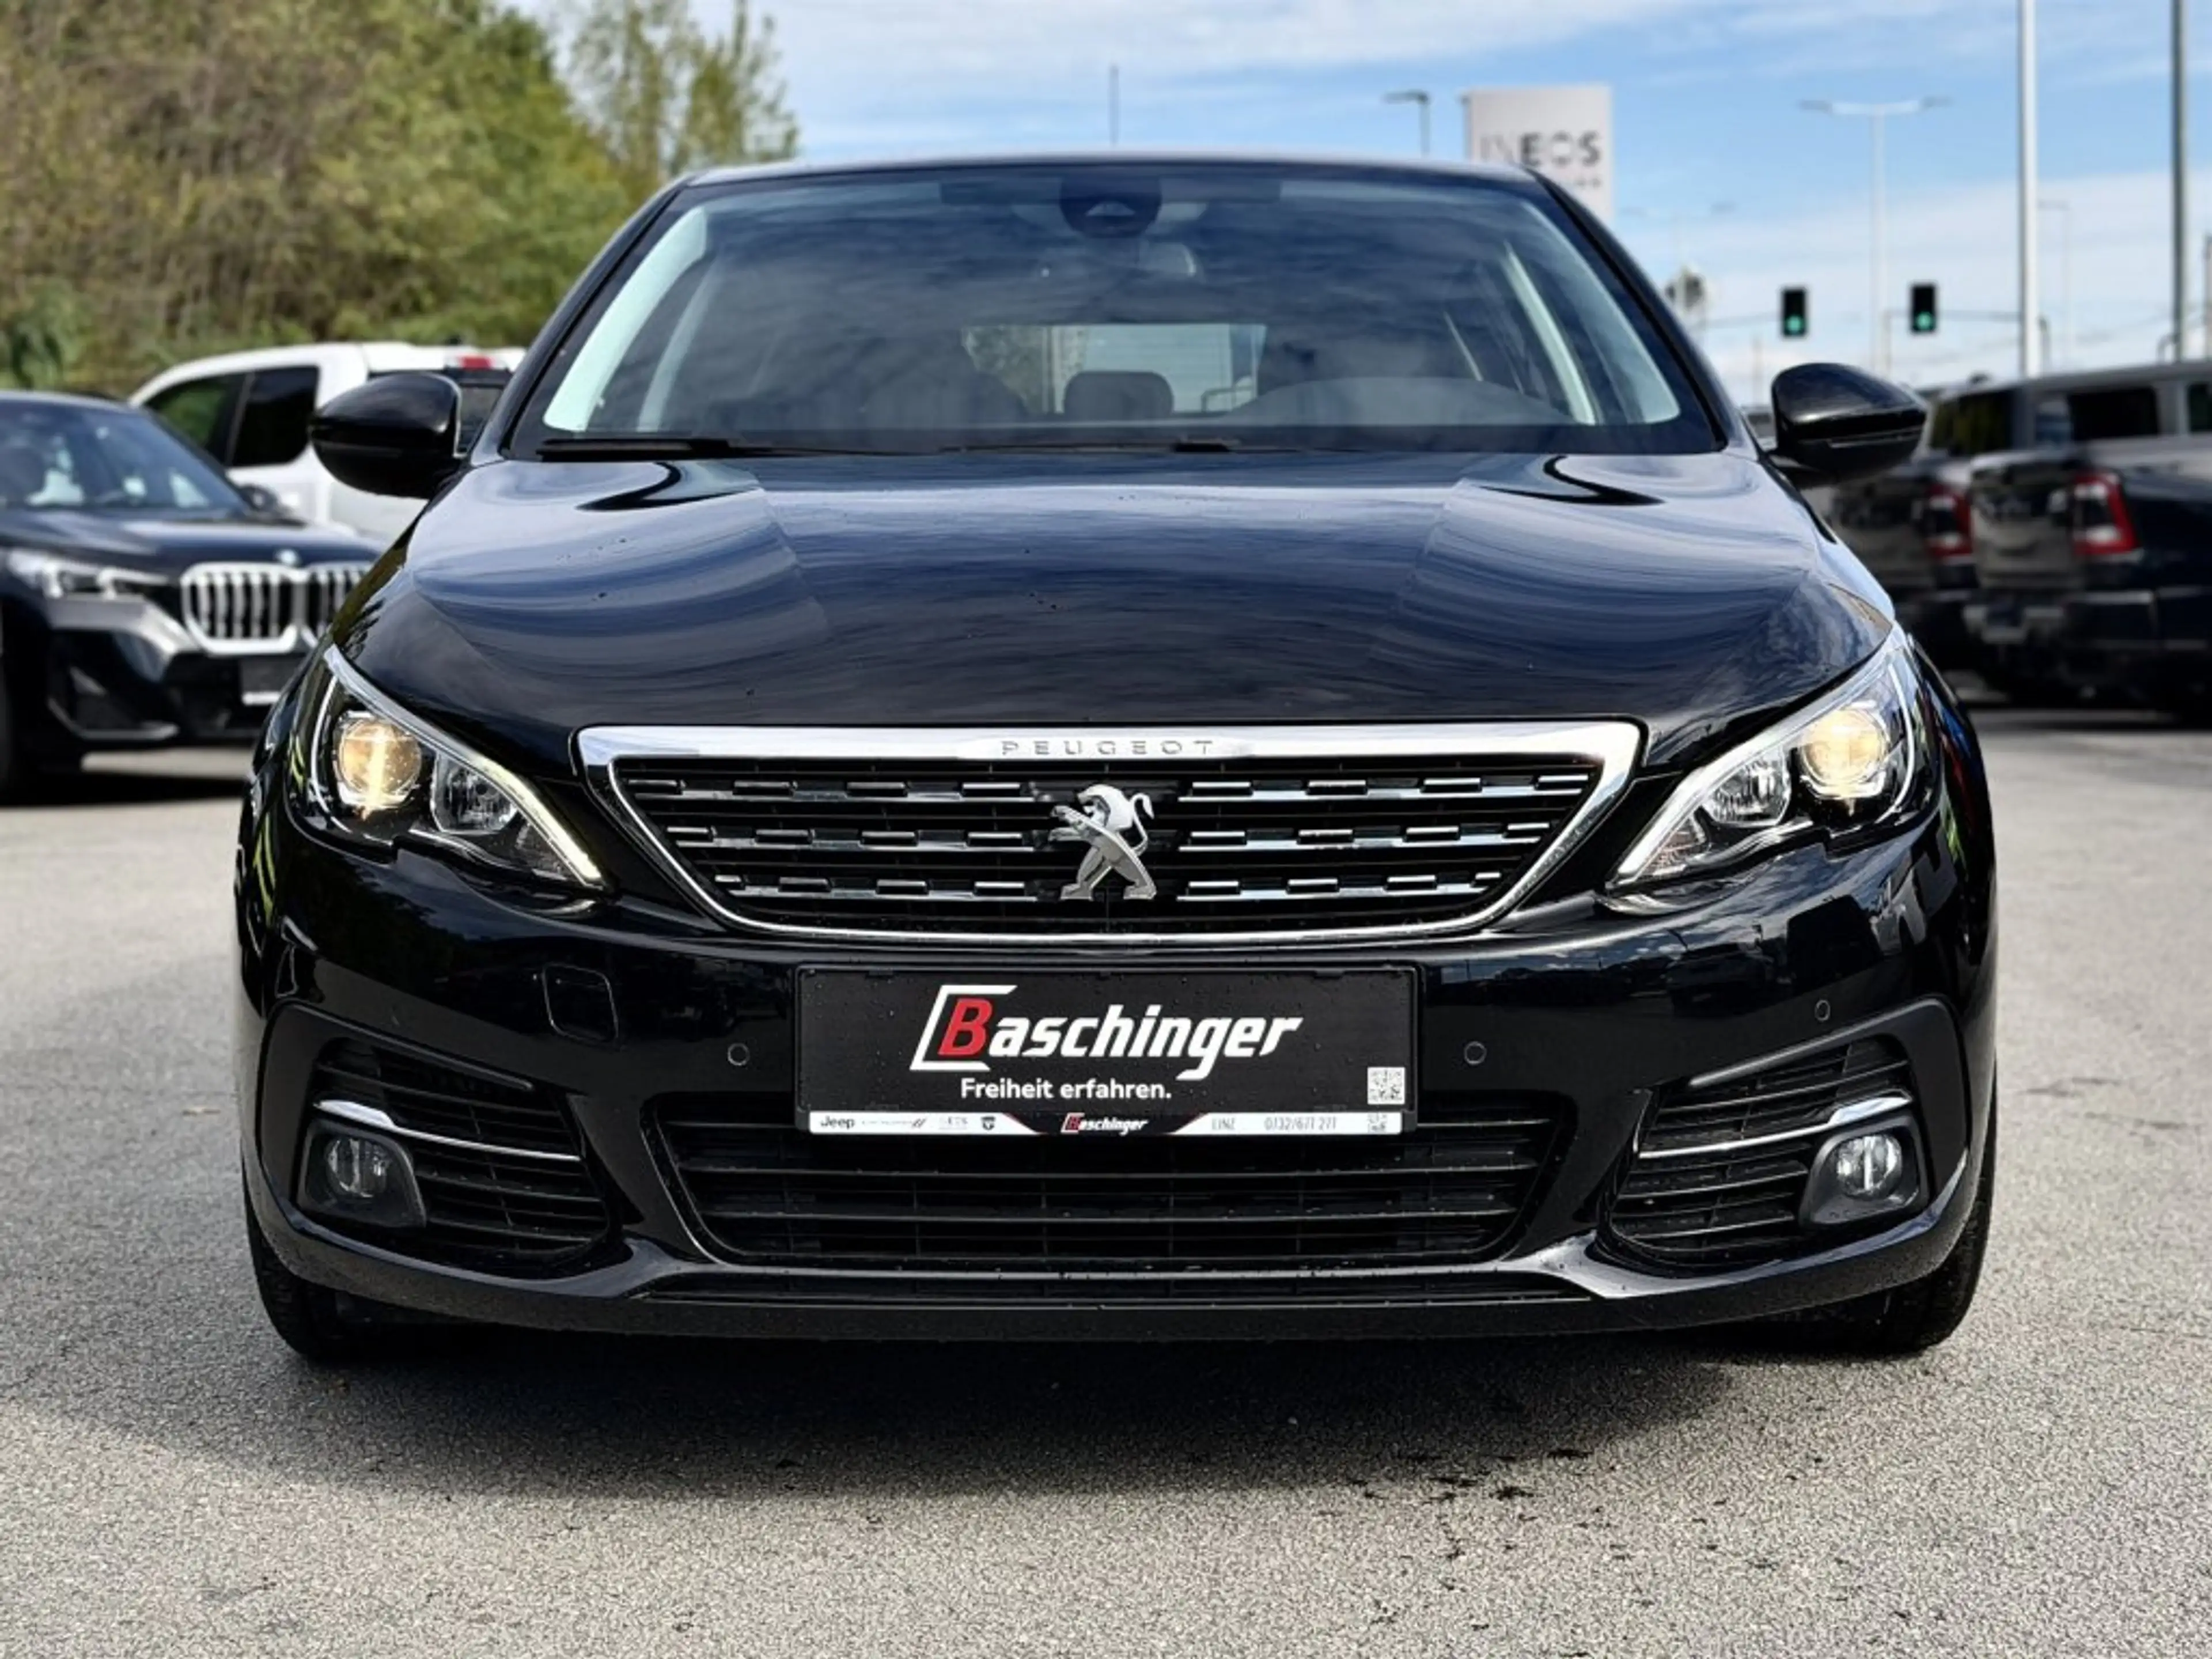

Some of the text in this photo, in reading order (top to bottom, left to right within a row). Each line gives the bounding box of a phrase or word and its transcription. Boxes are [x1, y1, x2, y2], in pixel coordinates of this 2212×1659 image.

[1001, 741, 1213, 755] PEUGEOT
[937, 997, 1304, 1081] Baschinger
[960, 1078, 1172, 1099] Freiheit erfahren.
[820, 1115, 855, 1130] Jeep
